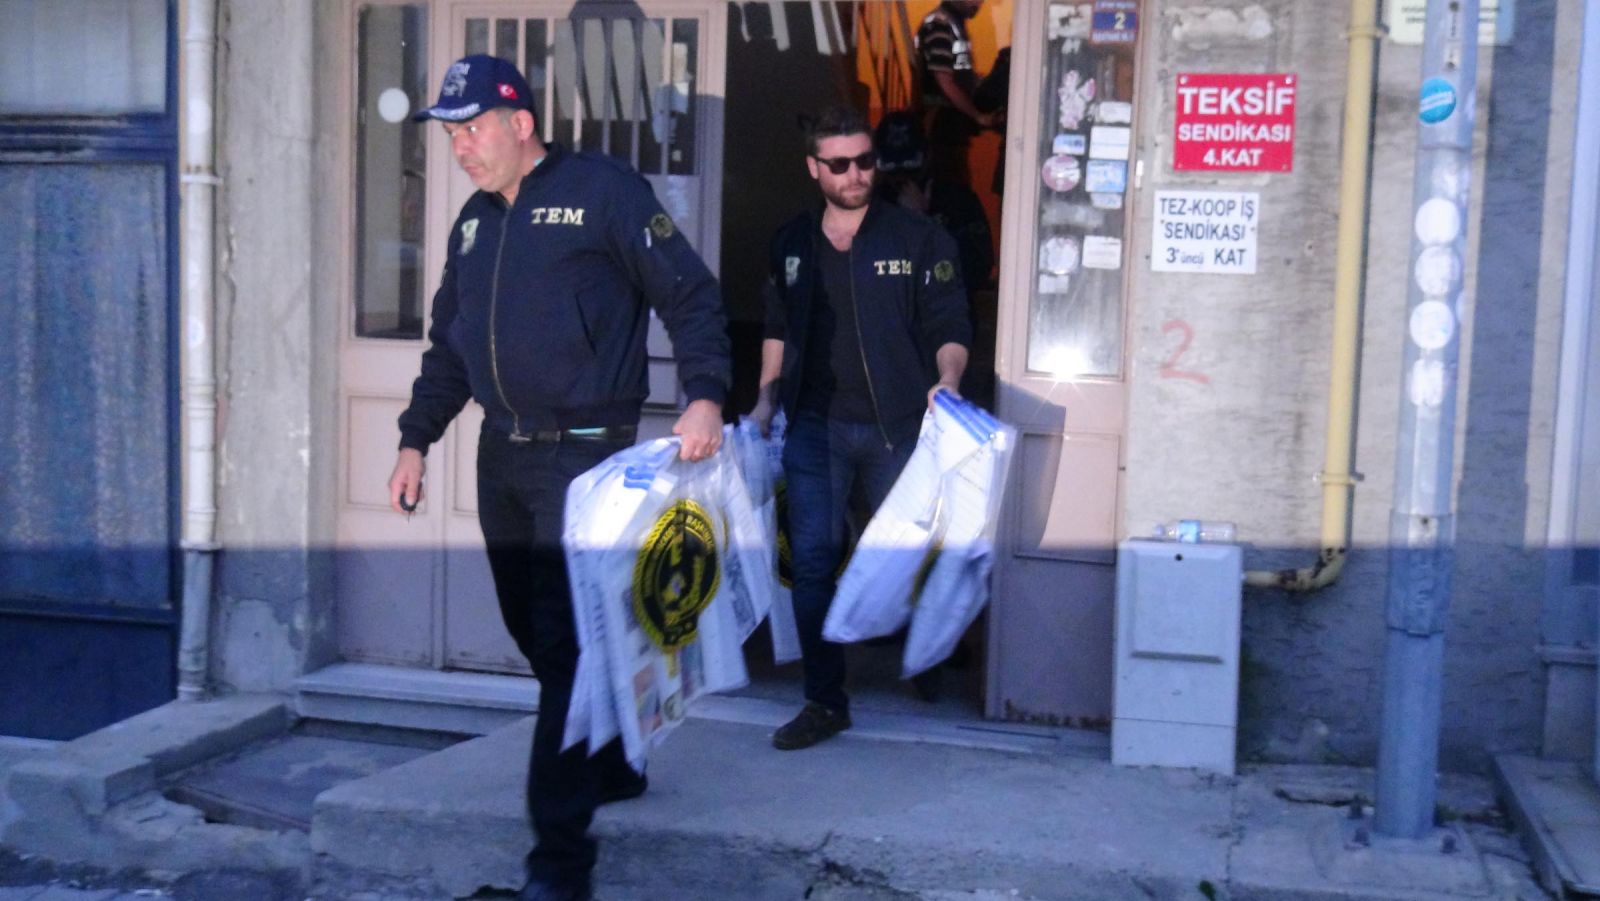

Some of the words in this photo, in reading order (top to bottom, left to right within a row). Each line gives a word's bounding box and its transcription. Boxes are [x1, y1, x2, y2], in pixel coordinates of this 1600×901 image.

[1114, 12, 1126, 30] 2
[1178, 81, 1294, 115] TEKSİF
[1178, 120, 1291, 142] SENDİKASI
[1203, 148, 1263, 166] 4.KAT
[531, 207, 586, 227] TEM
[1160, 198, 1236, 216] TEZ-KOOP
[1241, 196, 1254, 221] İŞ
[874, 259, 912, 275] TEM
[1214, 248, 1247, 266] KAT
[1158, 319, 1211, 384] 2
